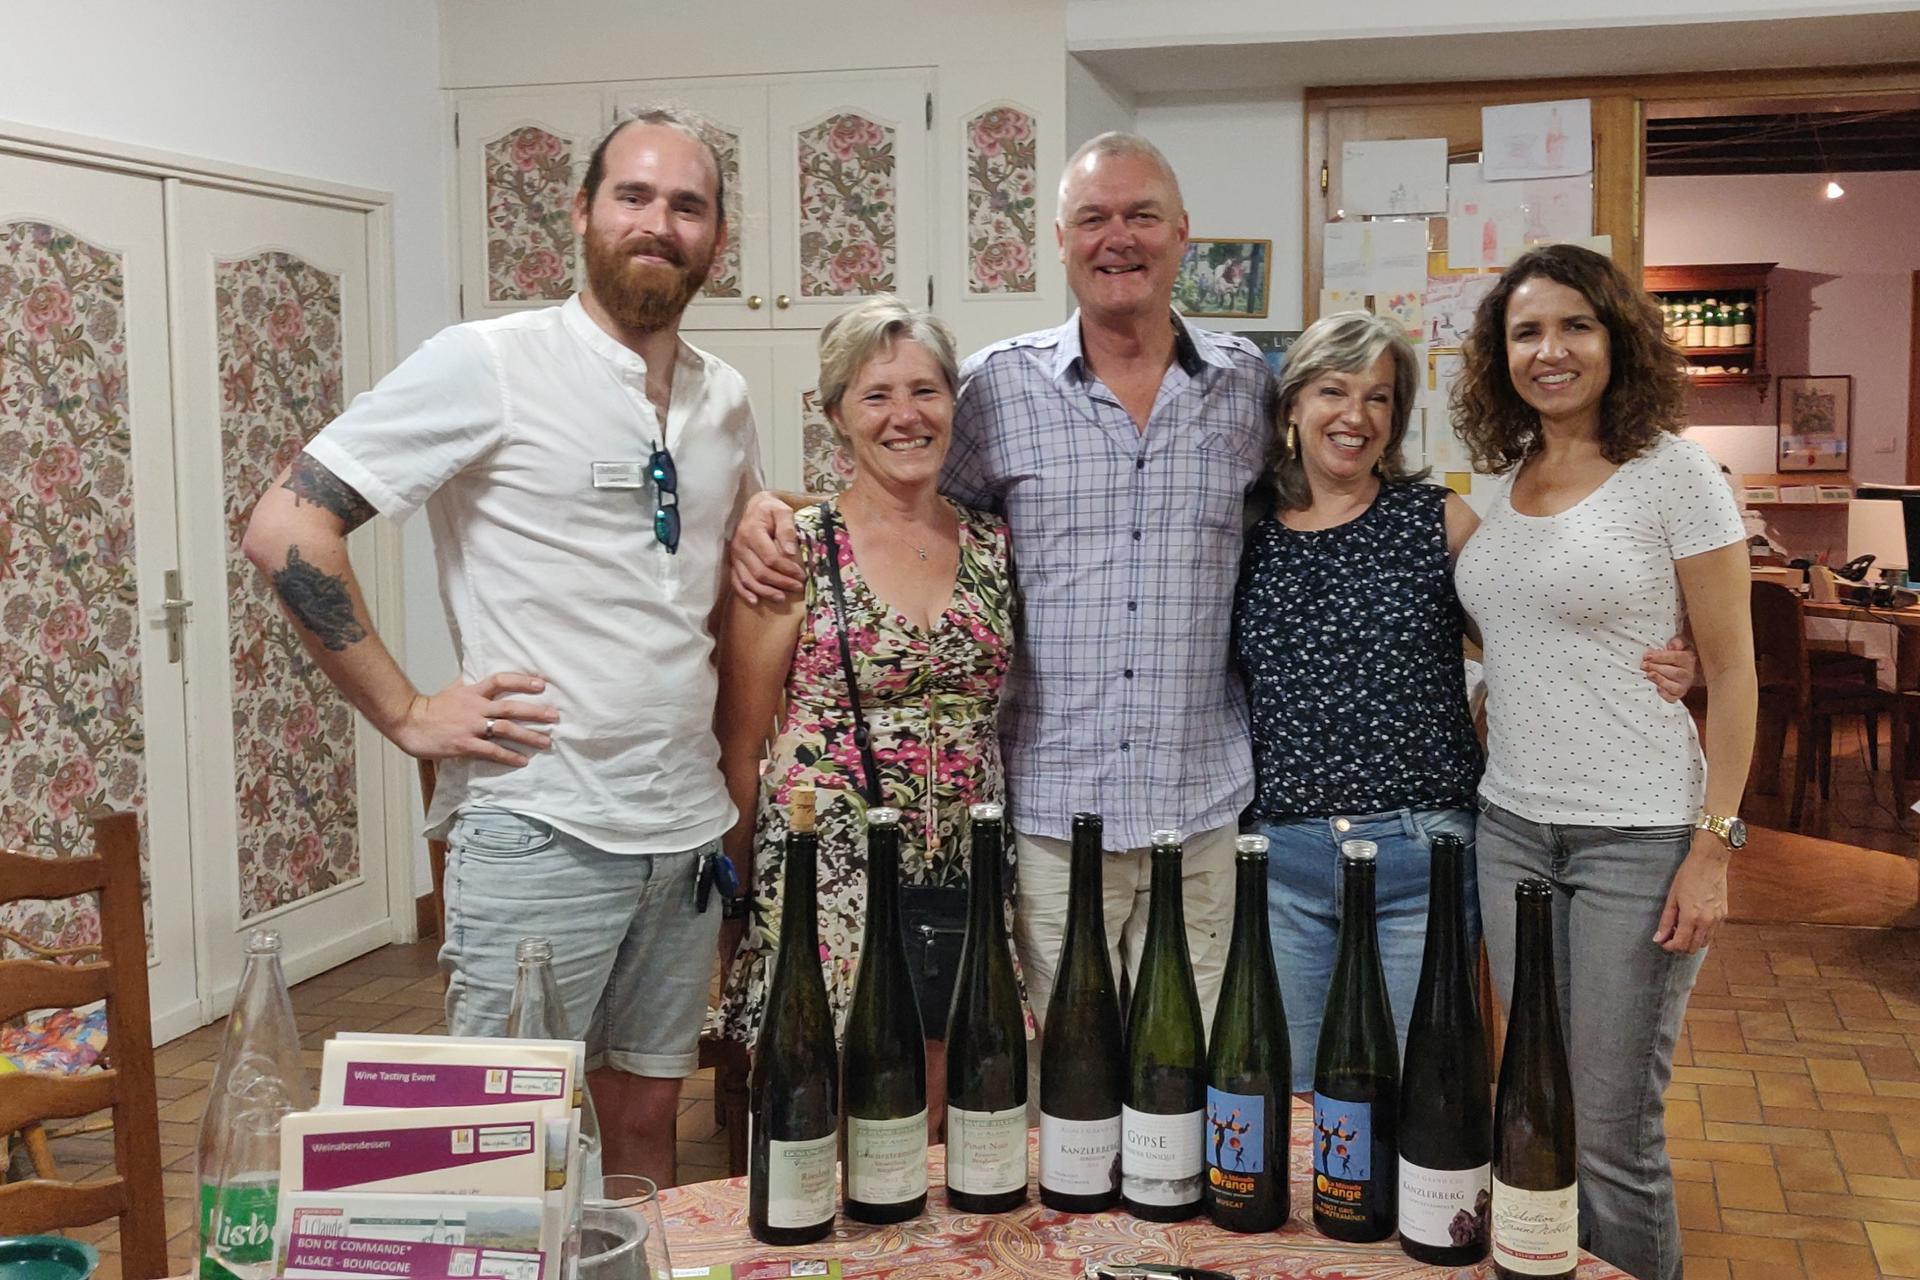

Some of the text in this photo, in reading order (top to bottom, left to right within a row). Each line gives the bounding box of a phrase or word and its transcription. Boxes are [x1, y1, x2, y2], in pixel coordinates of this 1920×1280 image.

[354, 1071, 436, 1083] Wine Tasting Event
[312, 1140, 391, 1153] Weinabendessen
[1403, 1180, 1465, 1200] KANZLERBERG
[1216, 1197, 1244, 1209] MUSCAT
[210, 1208, 277, 1252] Lisb
[298, 1238, 321, 1249] BON
[324, 1239, 337, 1250] DE
[294, 1254, 333, 1267] ALSACE
[343, 1257, 412, 1273] BOURGOGNE
